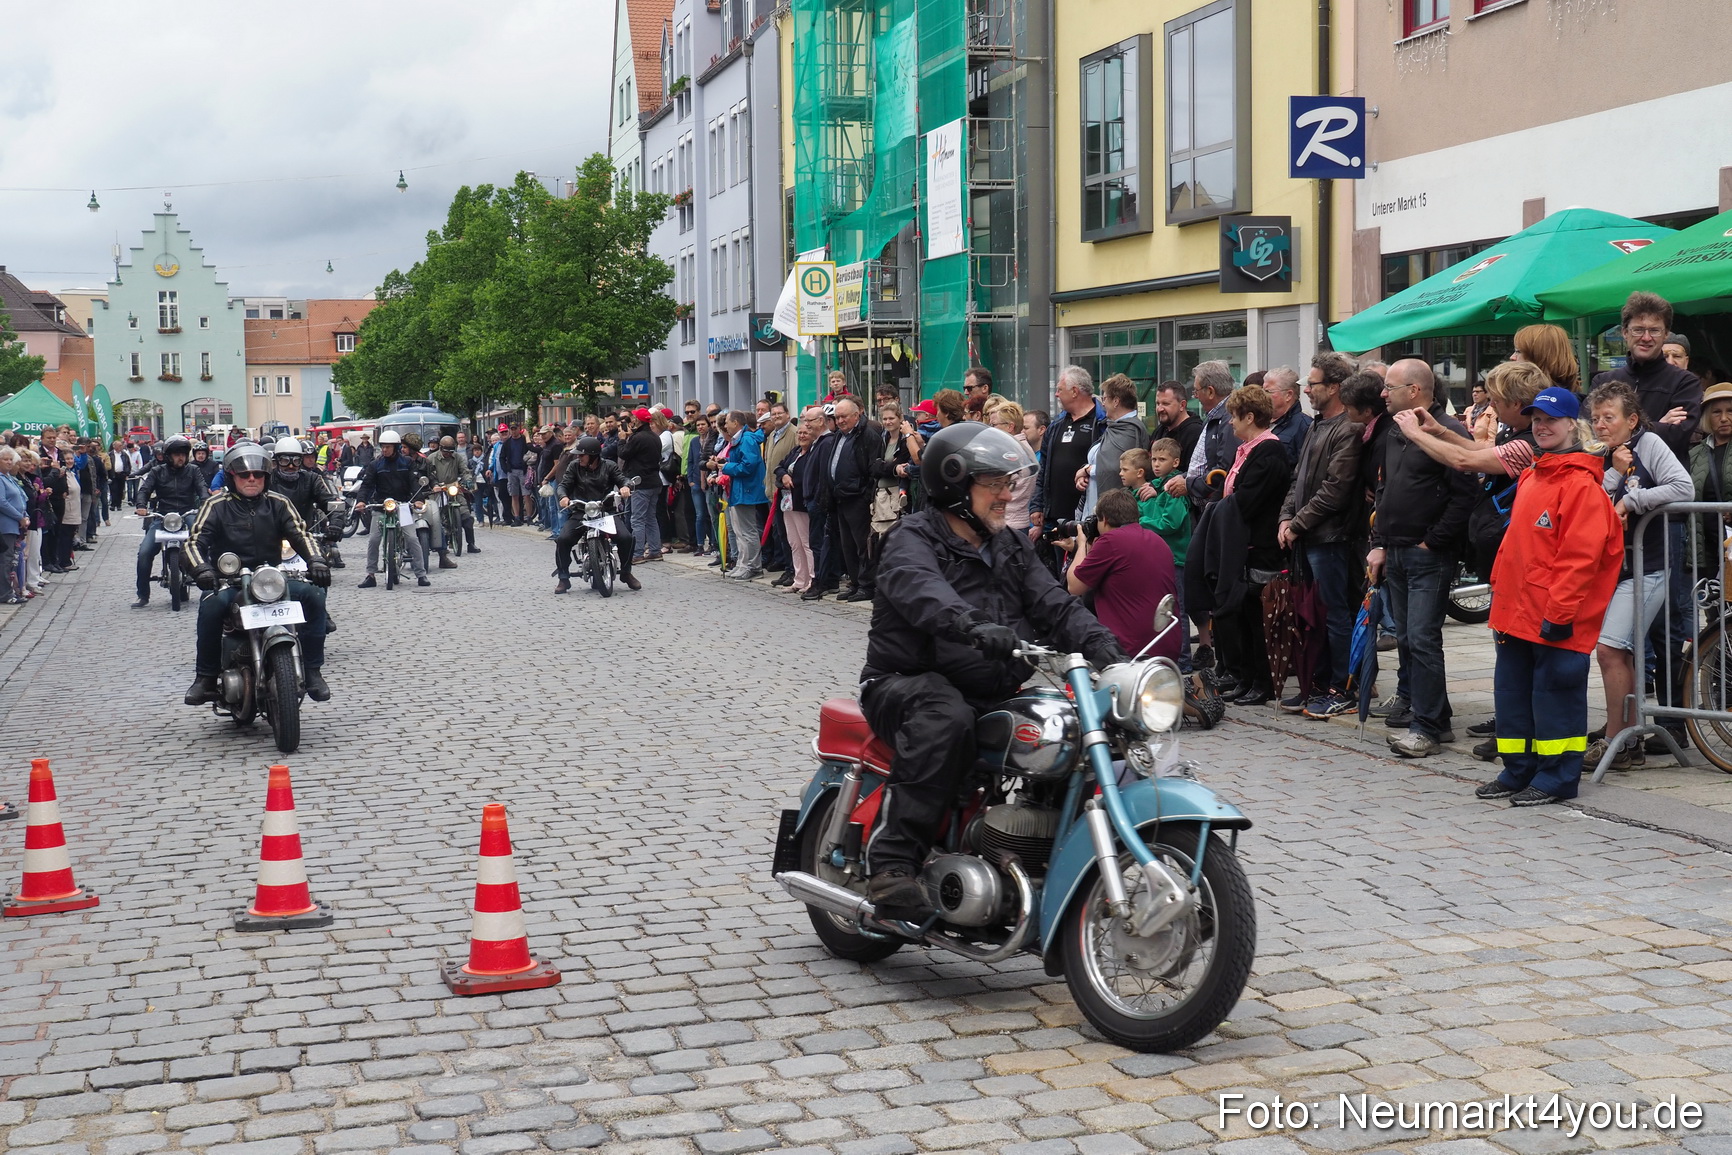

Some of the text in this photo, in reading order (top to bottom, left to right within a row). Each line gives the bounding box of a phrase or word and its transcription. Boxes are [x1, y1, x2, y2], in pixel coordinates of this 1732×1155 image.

[1372, 192, 1426, 216] Unterer Markt 15
[1632, 249, 1732, 274] Lammsbr
[810, 274, 822, 290] H
[271, 608, 290, 618] 487
